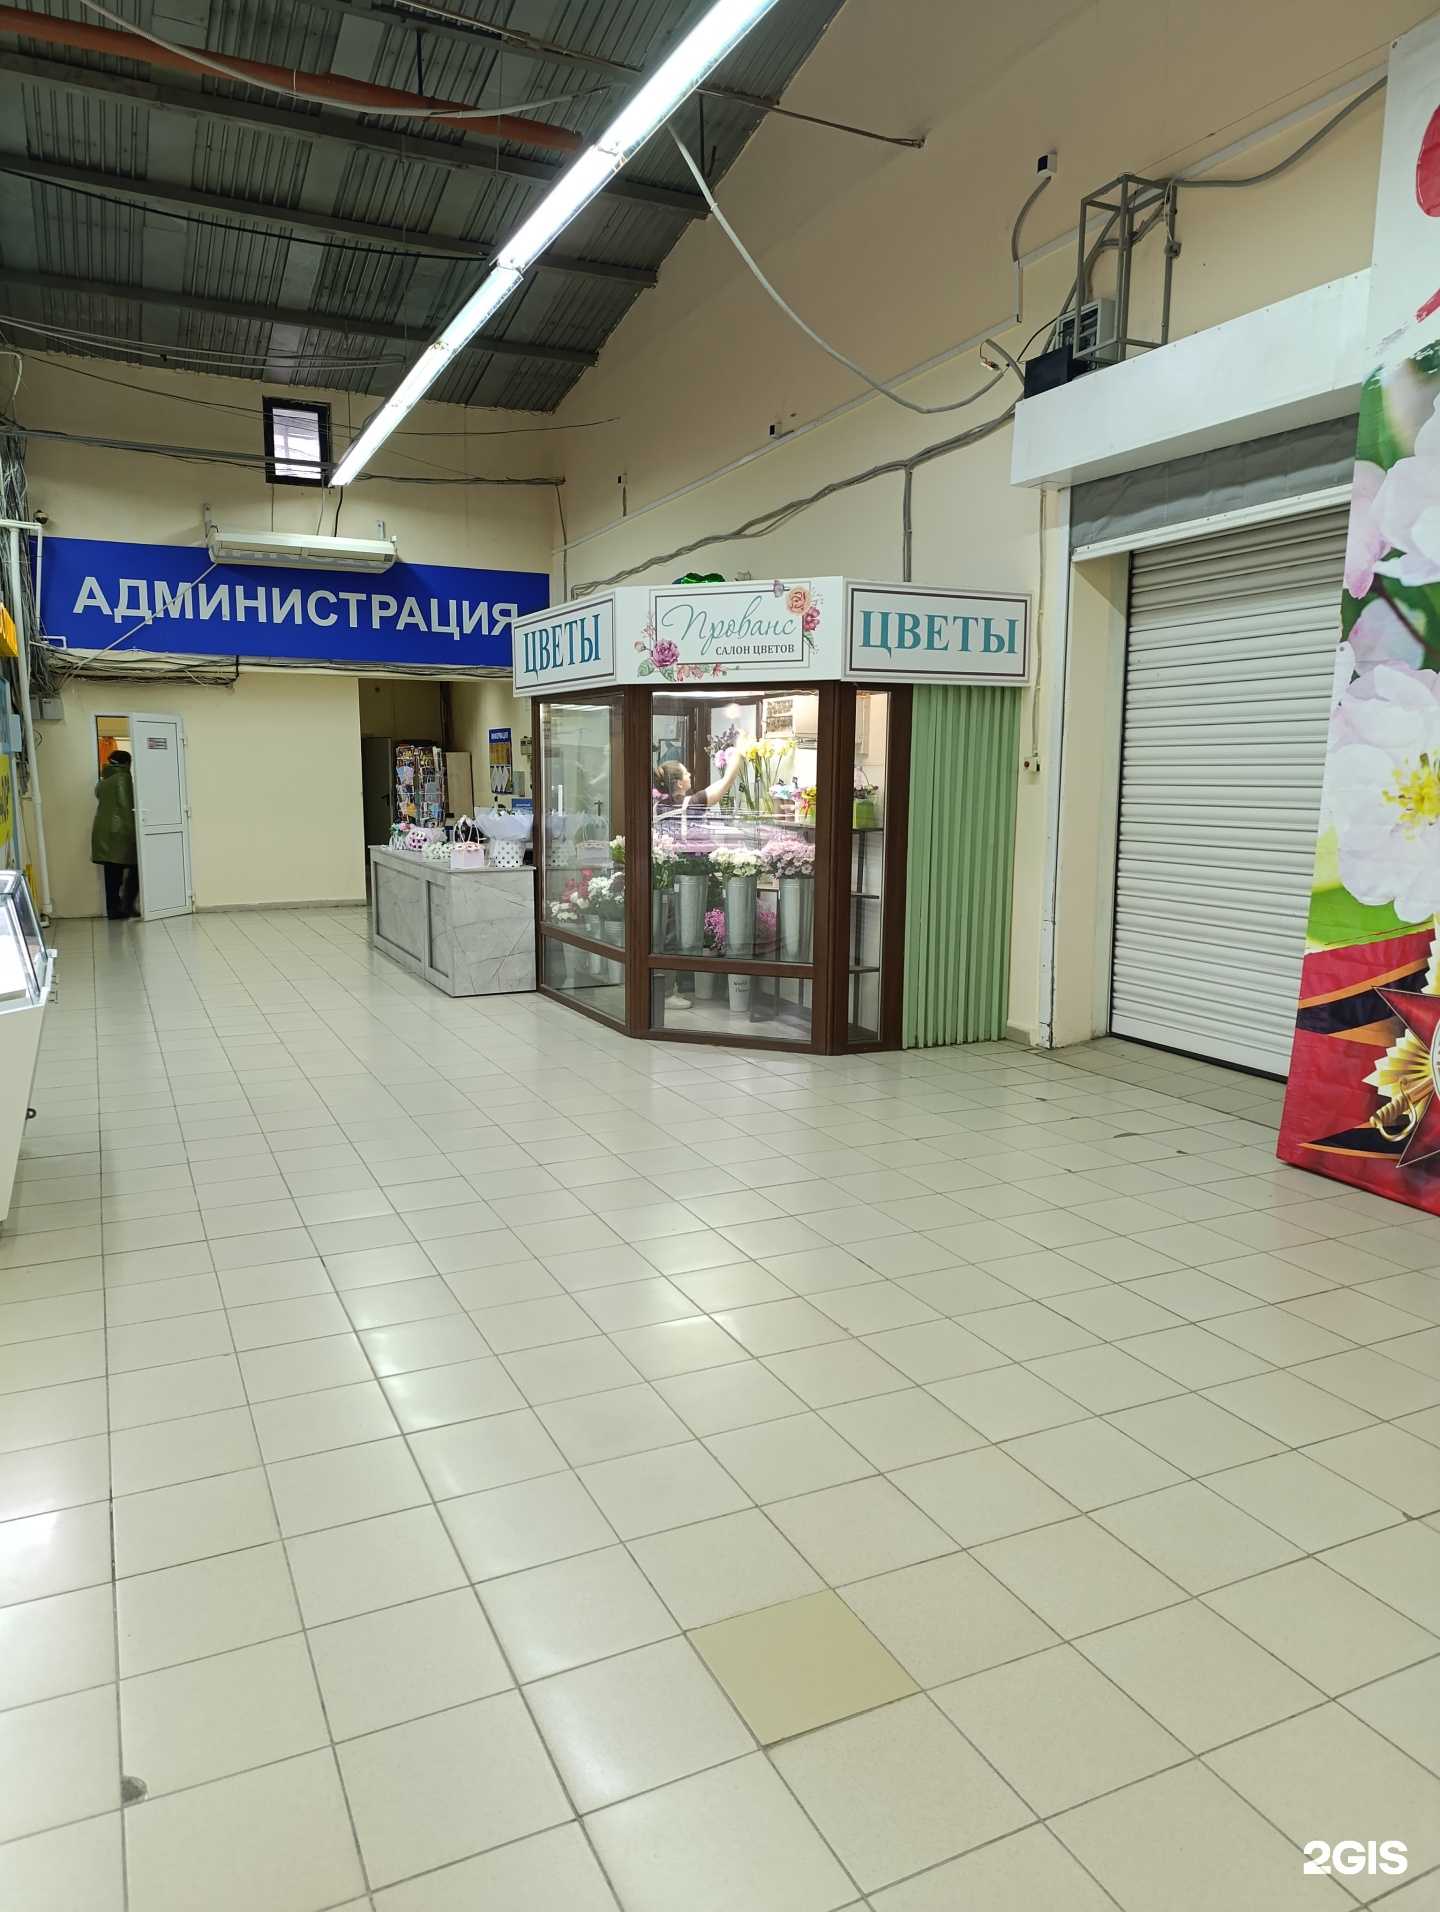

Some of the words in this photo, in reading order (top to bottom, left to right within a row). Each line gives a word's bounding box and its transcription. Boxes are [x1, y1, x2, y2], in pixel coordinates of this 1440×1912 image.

[73, 576, 518, 640] АДМИНИСТРАЦИЯ
[661, 595, 797, 656] Прованс
[858, 610, 1020, 658] ЦВЕТЫ
[523, 613, 601, 675] ЦВЕТЫ
[715, 645, 751, 656] САЛОН
[753, 644, 795, 656] ЦВЕТОВ
